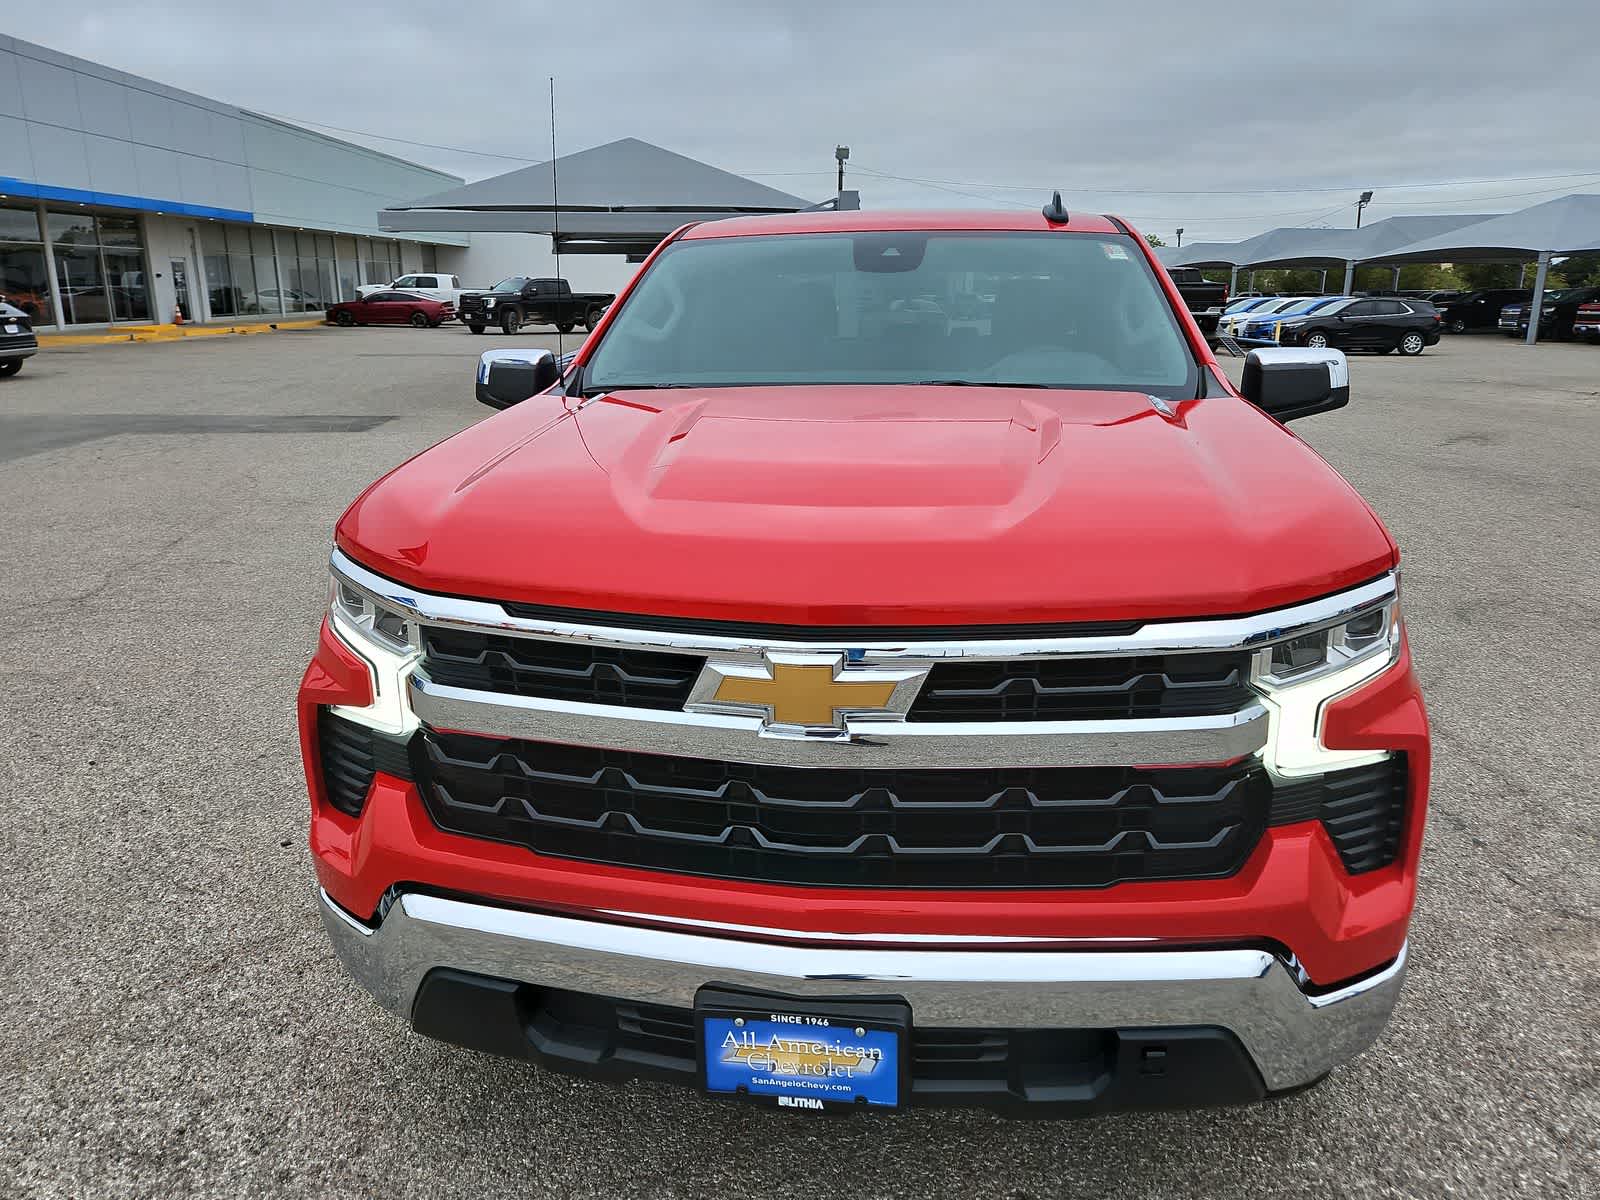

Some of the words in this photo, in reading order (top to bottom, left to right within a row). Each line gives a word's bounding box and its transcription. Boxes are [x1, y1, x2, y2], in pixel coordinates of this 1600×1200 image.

[770, 1014, 802, 1025] SINCE
[805, 1016, 830, 1027] 1946
[720, 1031, 756, 1049] All
[766, 1033, 883, 1060] American
[747, 1052, 854, 1078] Chevrolet
[751, 1077, 852, 1092] SanAngeloChevy.com
[788, 1097, 824, 1110] LITHIA
